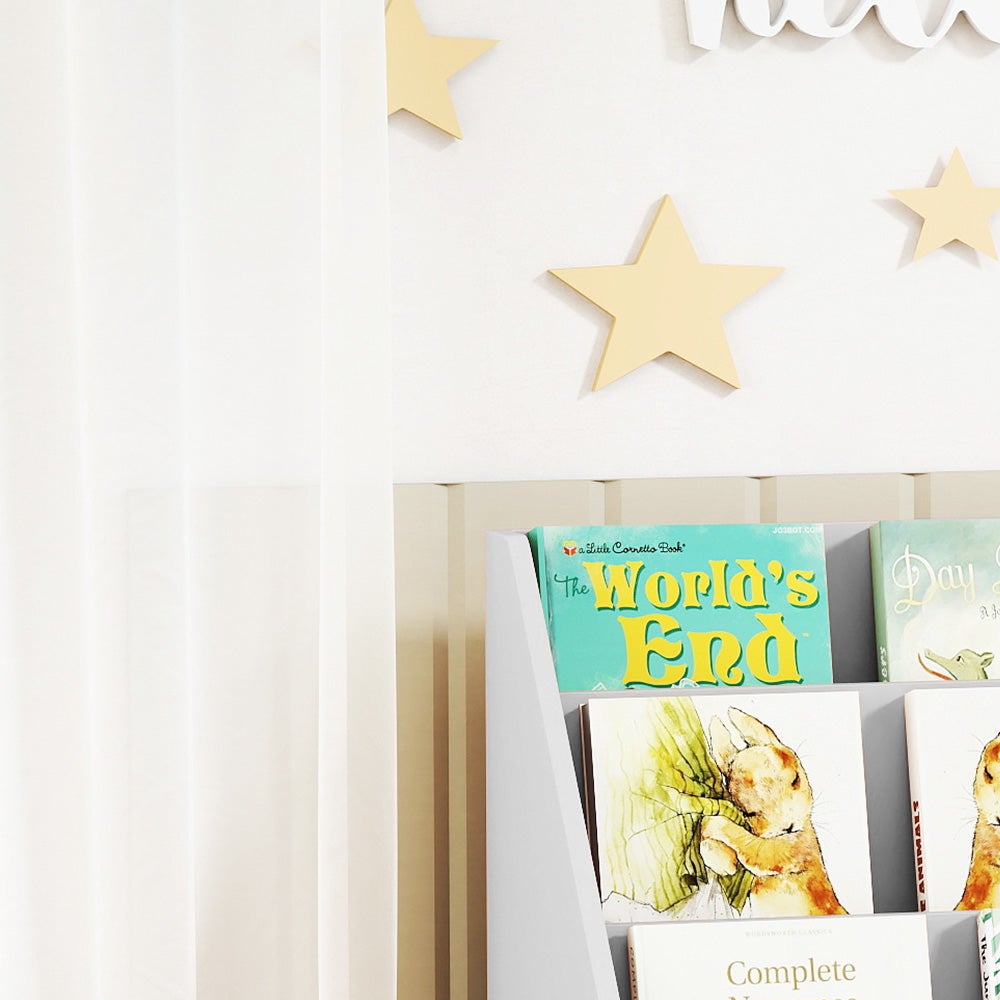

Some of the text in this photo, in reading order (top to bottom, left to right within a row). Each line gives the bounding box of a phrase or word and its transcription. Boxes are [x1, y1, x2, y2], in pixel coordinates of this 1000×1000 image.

[586, 543, 611, 554] Little
[612, 541, 657, 554] Cornetto
[554, 559, 820, 610] The World's
[892, 544, 977, 614] Day
[980, 604, 989, 620] A
[617, 613, 804, 687] End
[726, 957, 857, 990] Complete
